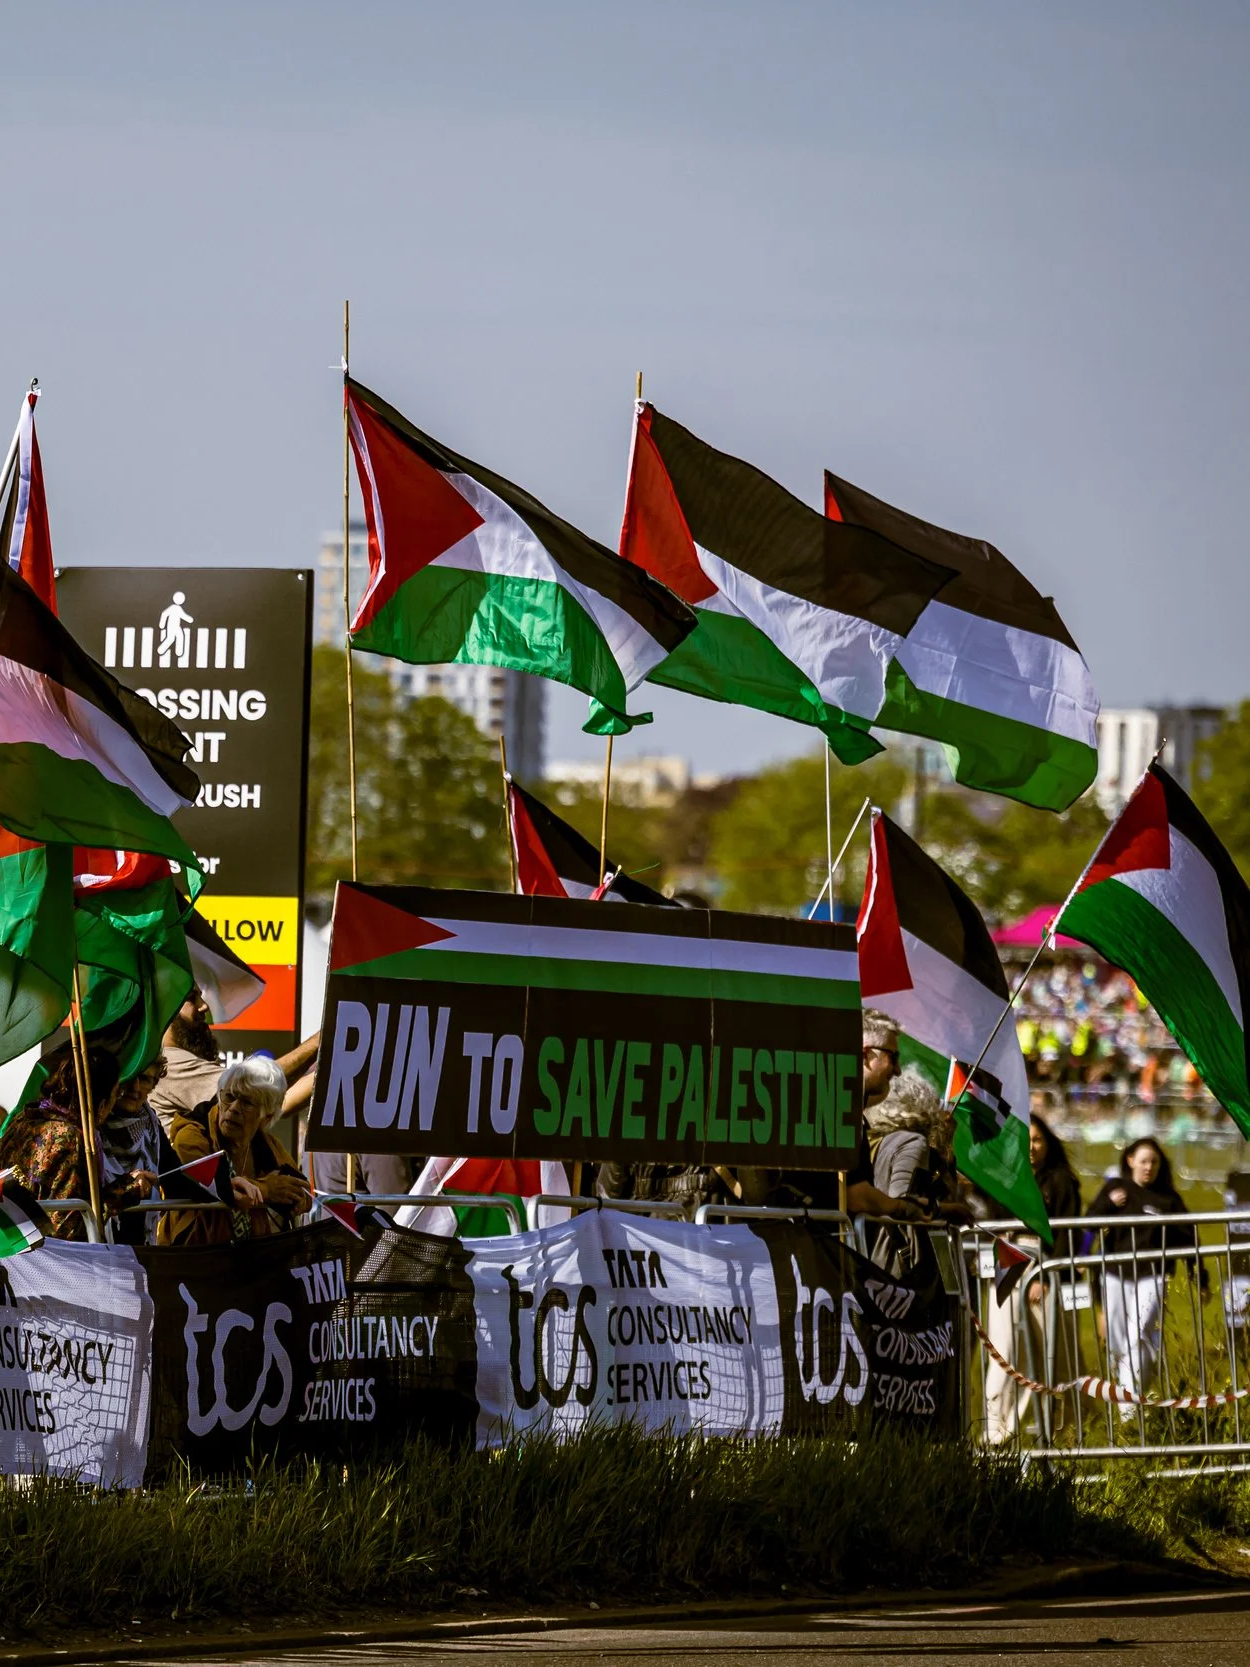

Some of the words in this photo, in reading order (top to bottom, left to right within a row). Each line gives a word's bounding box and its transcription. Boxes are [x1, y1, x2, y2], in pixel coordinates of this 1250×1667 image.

[134, 688, 267, 721] OSSING
[207, 920, 284, 942] LLOW
[321, 1000, 451, 1131] RUN
[462, 1032, 525, 1135] TO
[533, 1036, 652, 1139] SAVE
[656, 1043, 857, 1149] PALESTINE
[290, 1258, 347, 1305] TATA
[602, 1248, 668, 1289] TATA
[864, 1278, 916, 1320] TATA
[309, 1315, 439, 1365] CONSULTANCY
[501, 1264, 598, 1410] tcs
[607, 1304, 753, 1347] CONSULTANCY
[791, 1253, 869, 1407] tcs
[871, 1320, 955, 1366] ONSULTANC
[178, 1282, 293, 1437] tcs
[299, 1377, 376, 1423] SERVICES
[606, 1360, 712, 1406] SERVICES
